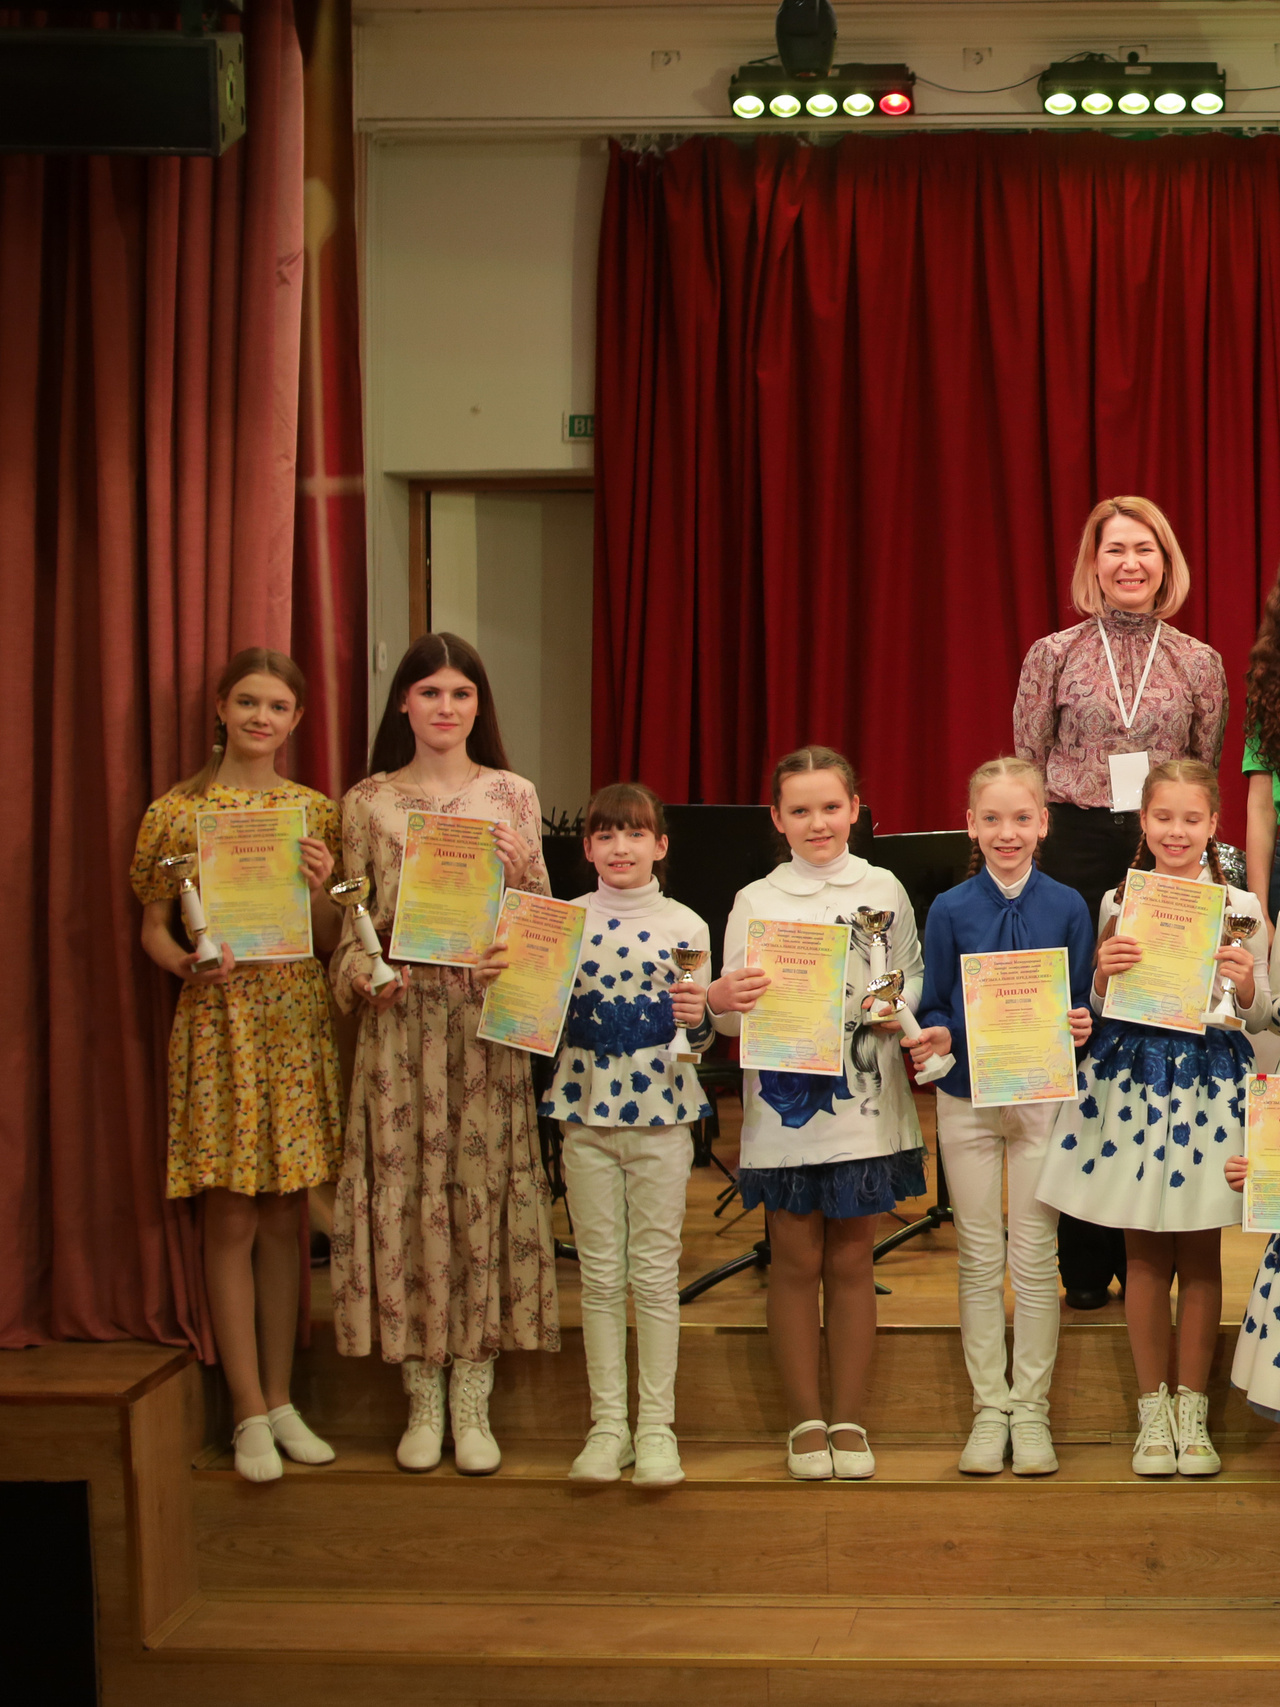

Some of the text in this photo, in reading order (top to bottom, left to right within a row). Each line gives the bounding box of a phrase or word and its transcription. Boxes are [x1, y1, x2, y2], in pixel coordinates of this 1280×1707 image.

[231, 845, 274, 856] Диплом
[434, 848, 476, 860] Диплом
[1152, 910, 1192, 923] Диплом
[521, 929, 558, 944] Диплом
[775, 955, 816, 966] Диплом
[996, 988, 1038, 998] Диплом
